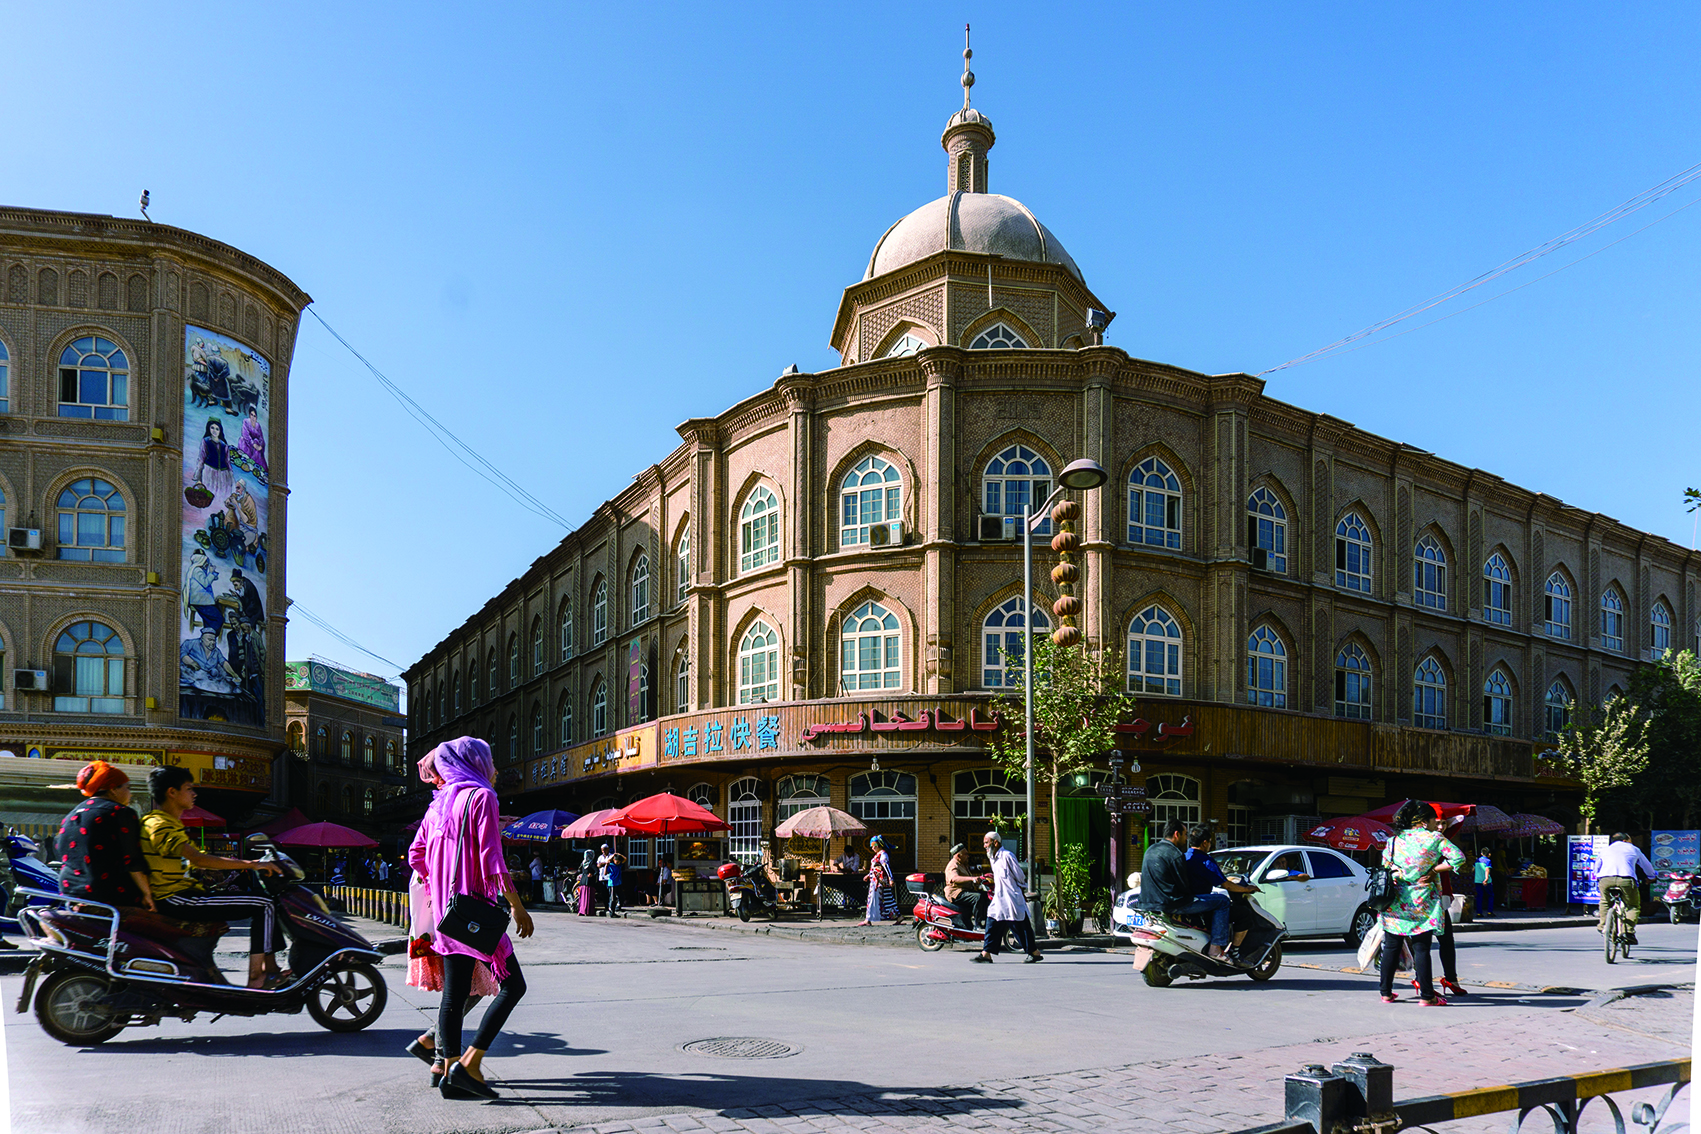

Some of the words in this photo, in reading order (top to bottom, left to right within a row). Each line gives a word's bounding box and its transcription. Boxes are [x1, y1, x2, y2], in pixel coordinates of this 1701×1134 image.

[664, 716, 780, 758] 湖吉拉快餐
